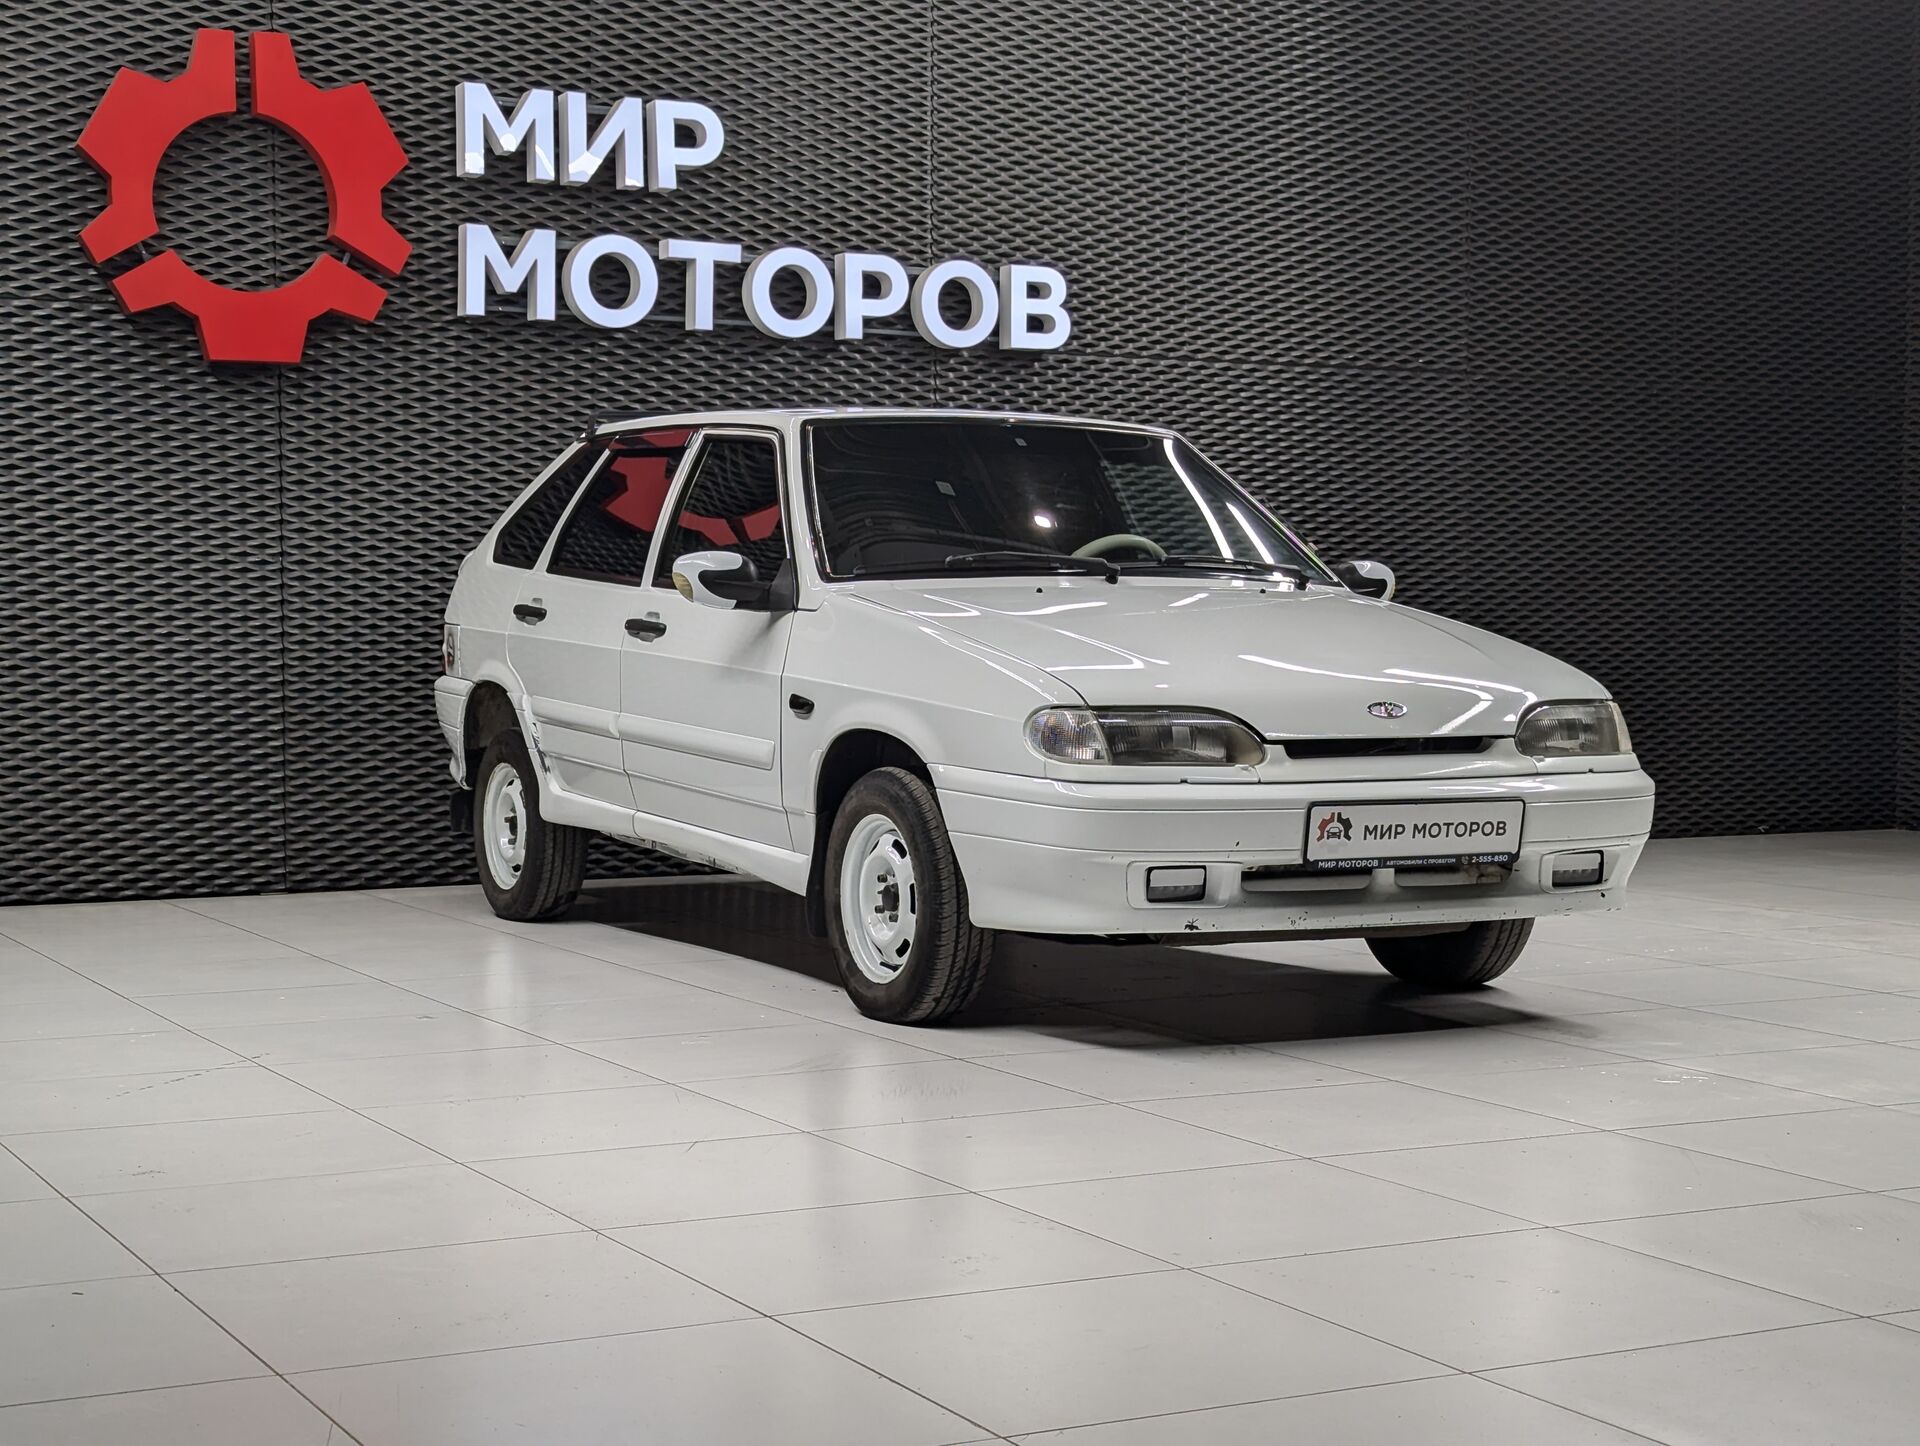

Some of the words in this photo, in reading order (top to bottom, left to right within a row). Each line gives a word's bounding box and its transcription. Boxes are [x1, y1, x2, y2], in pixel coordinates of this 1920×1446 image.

[455, 81, 725, 193] МИР
[456, 222, 1073, 351] МОТОРОВ
[1318, 860, 1337, 869] МИР
[1338, 859, 1378, 869] МОТОРОВ
[1472, 854, 1508, 863] 2-555-850
[1363, 824, 1406, 841] МИР
[1412, 821, 1507, 839] МОТОРОВ
